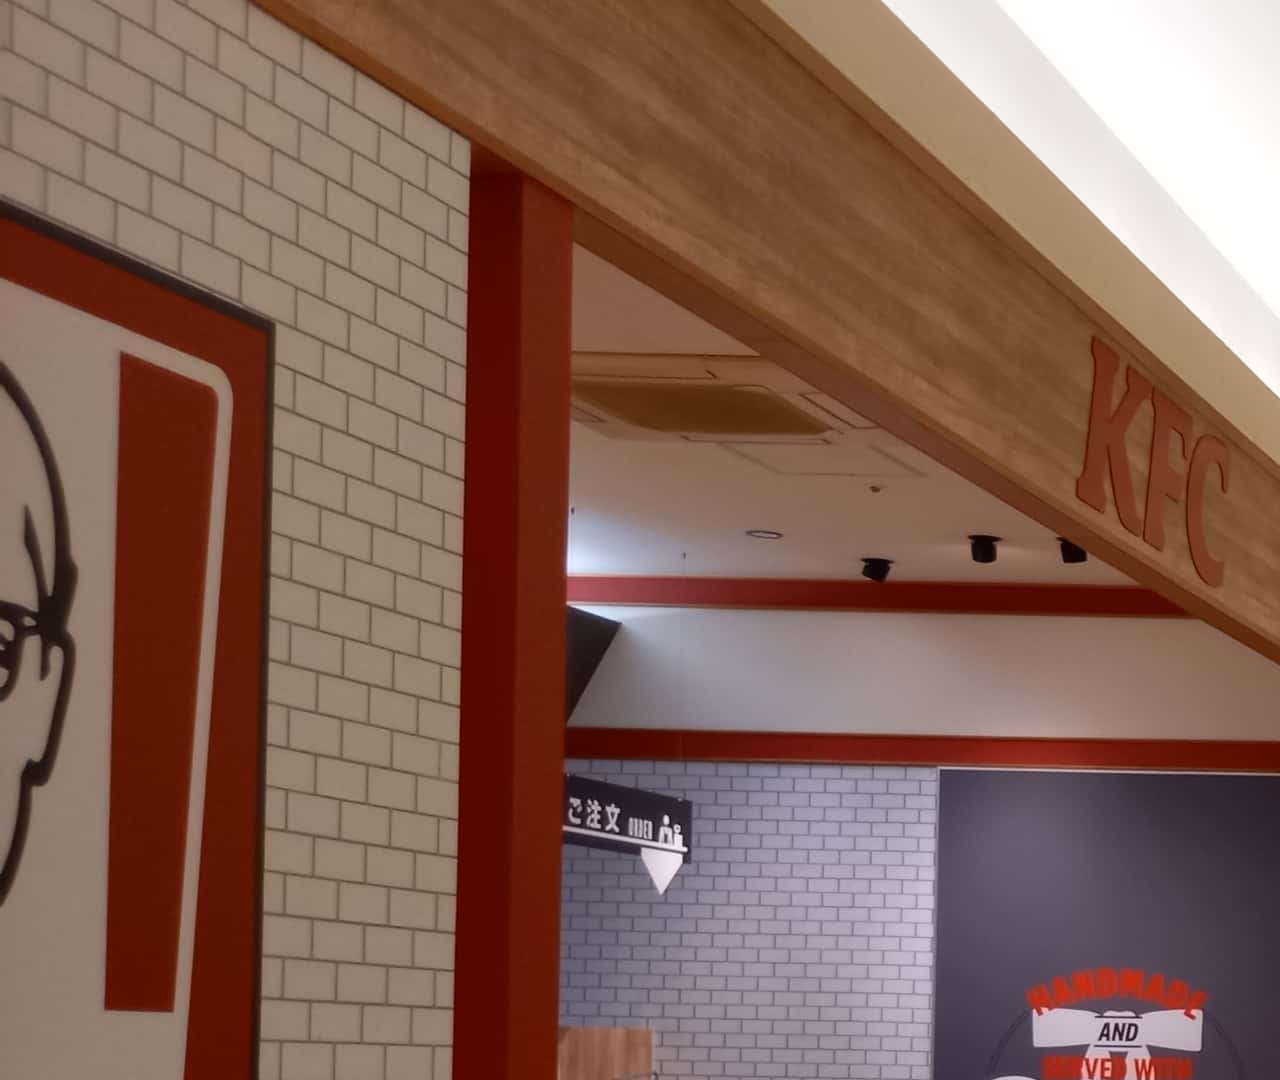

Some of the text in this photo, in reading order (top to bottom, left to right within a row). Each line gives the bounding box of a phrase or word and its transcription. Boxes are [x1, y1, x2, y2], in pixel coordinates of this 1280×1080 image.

[1075, 335, 1229, 588] KFC
[568, 797, 621, 832] ご注文
[1027, 967, 1209, 1020] HANDMADE
[1098, 1022, 1139, 1042] AND
[1134, 1056, 1193, 1080] WITH
